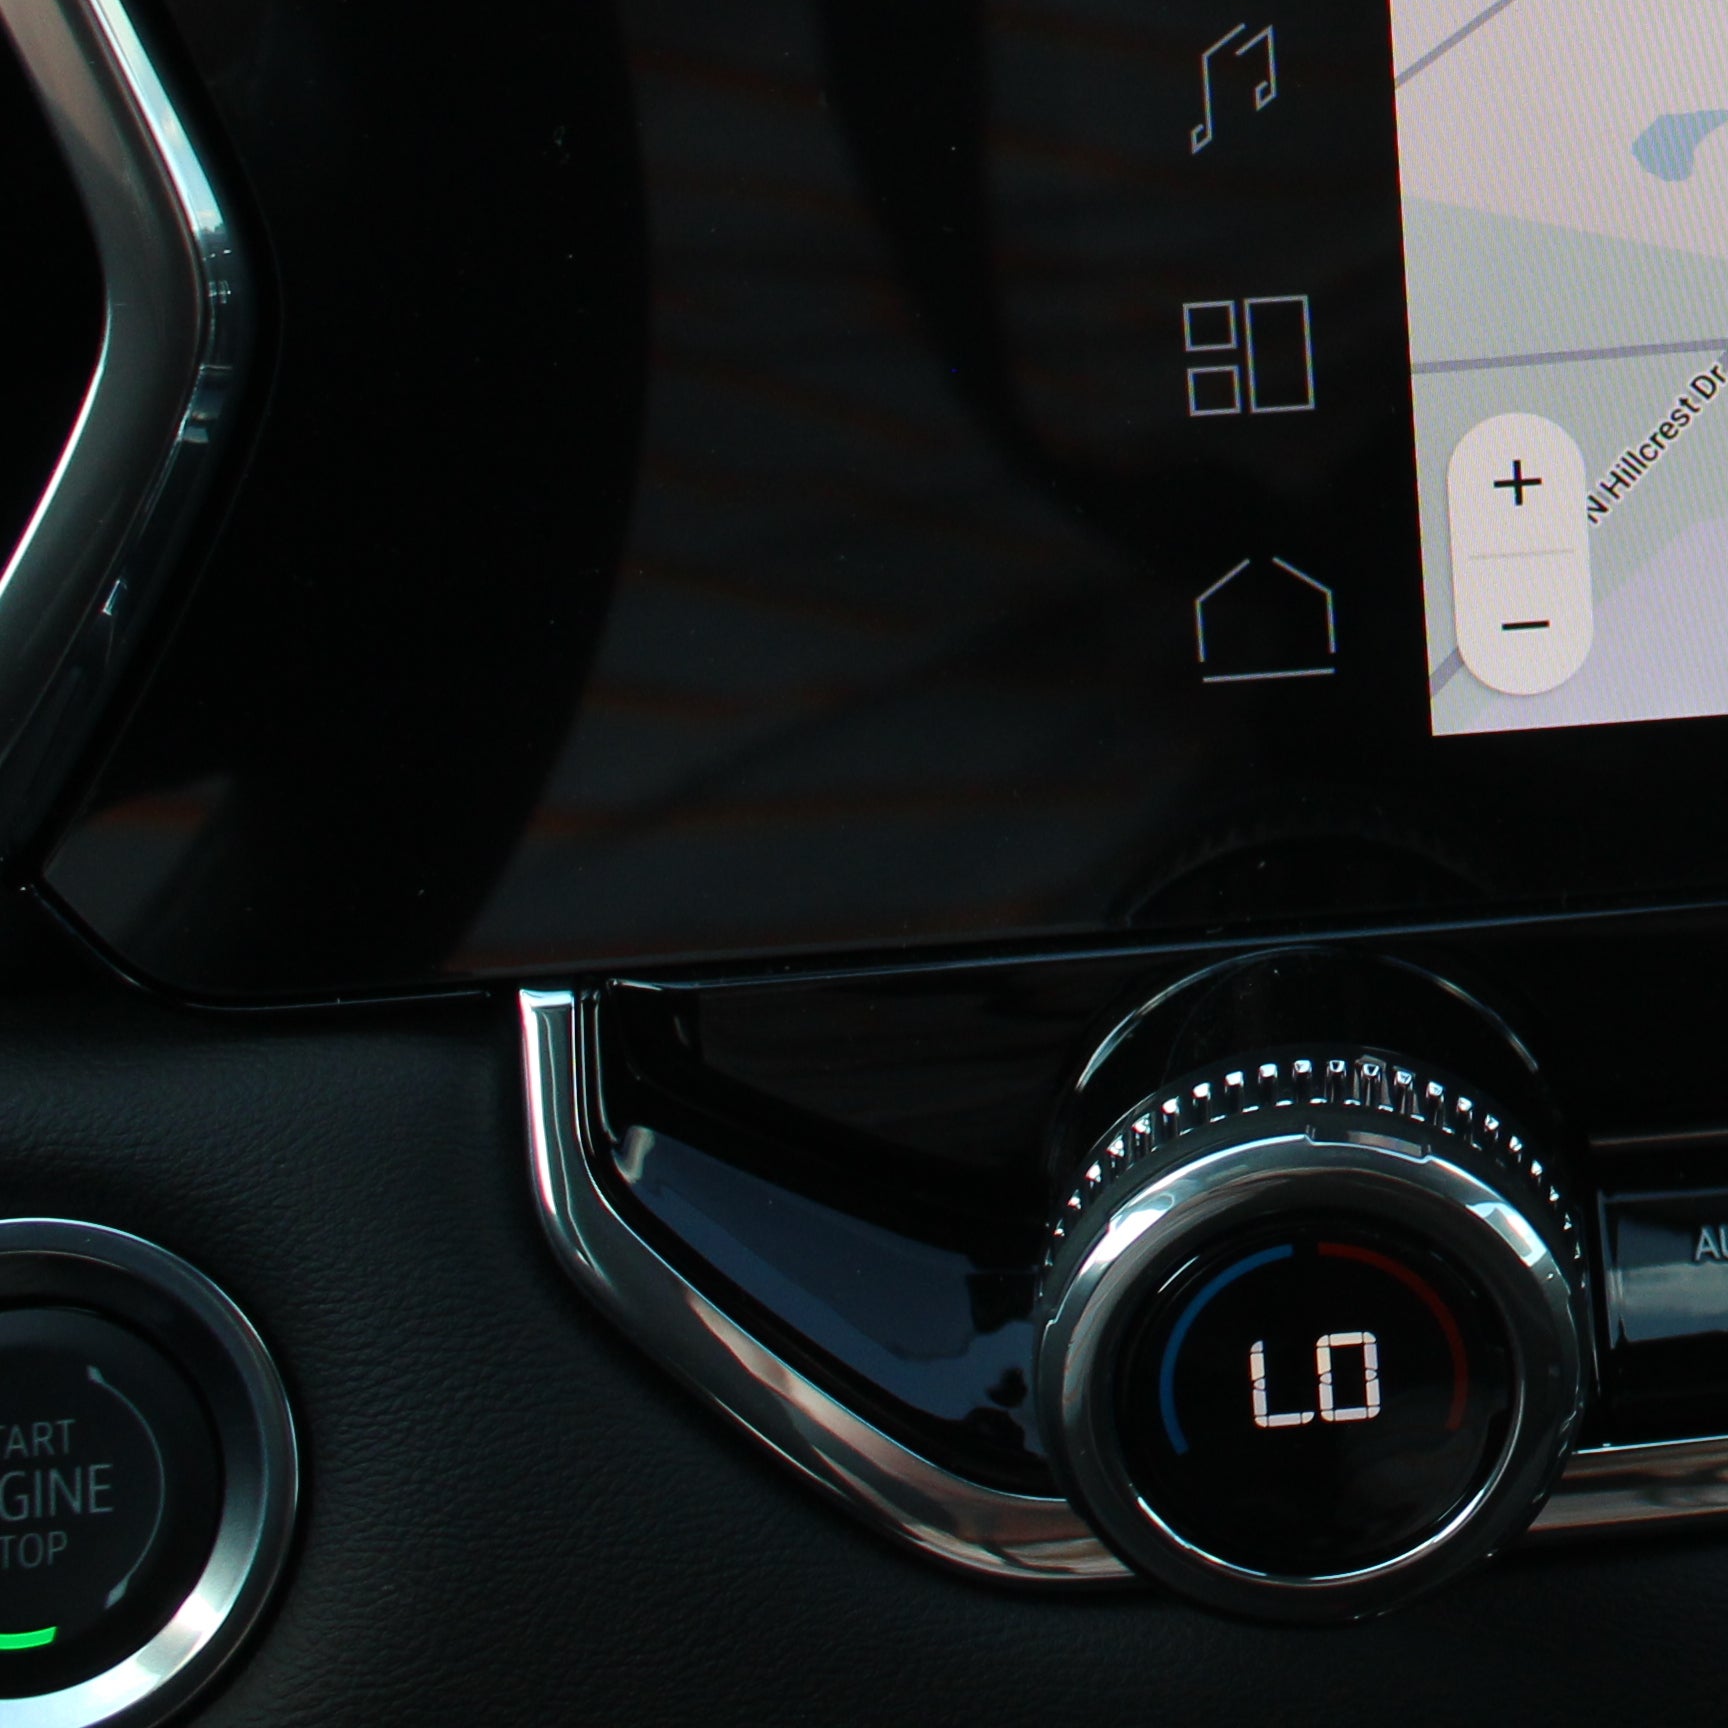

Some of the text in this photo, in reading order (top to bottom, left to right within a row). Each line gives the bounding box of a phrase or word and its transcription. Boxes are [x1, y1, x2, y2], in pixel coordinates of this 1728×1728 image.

[1586, 363, 1728, 524] N Hillcrest Dr
